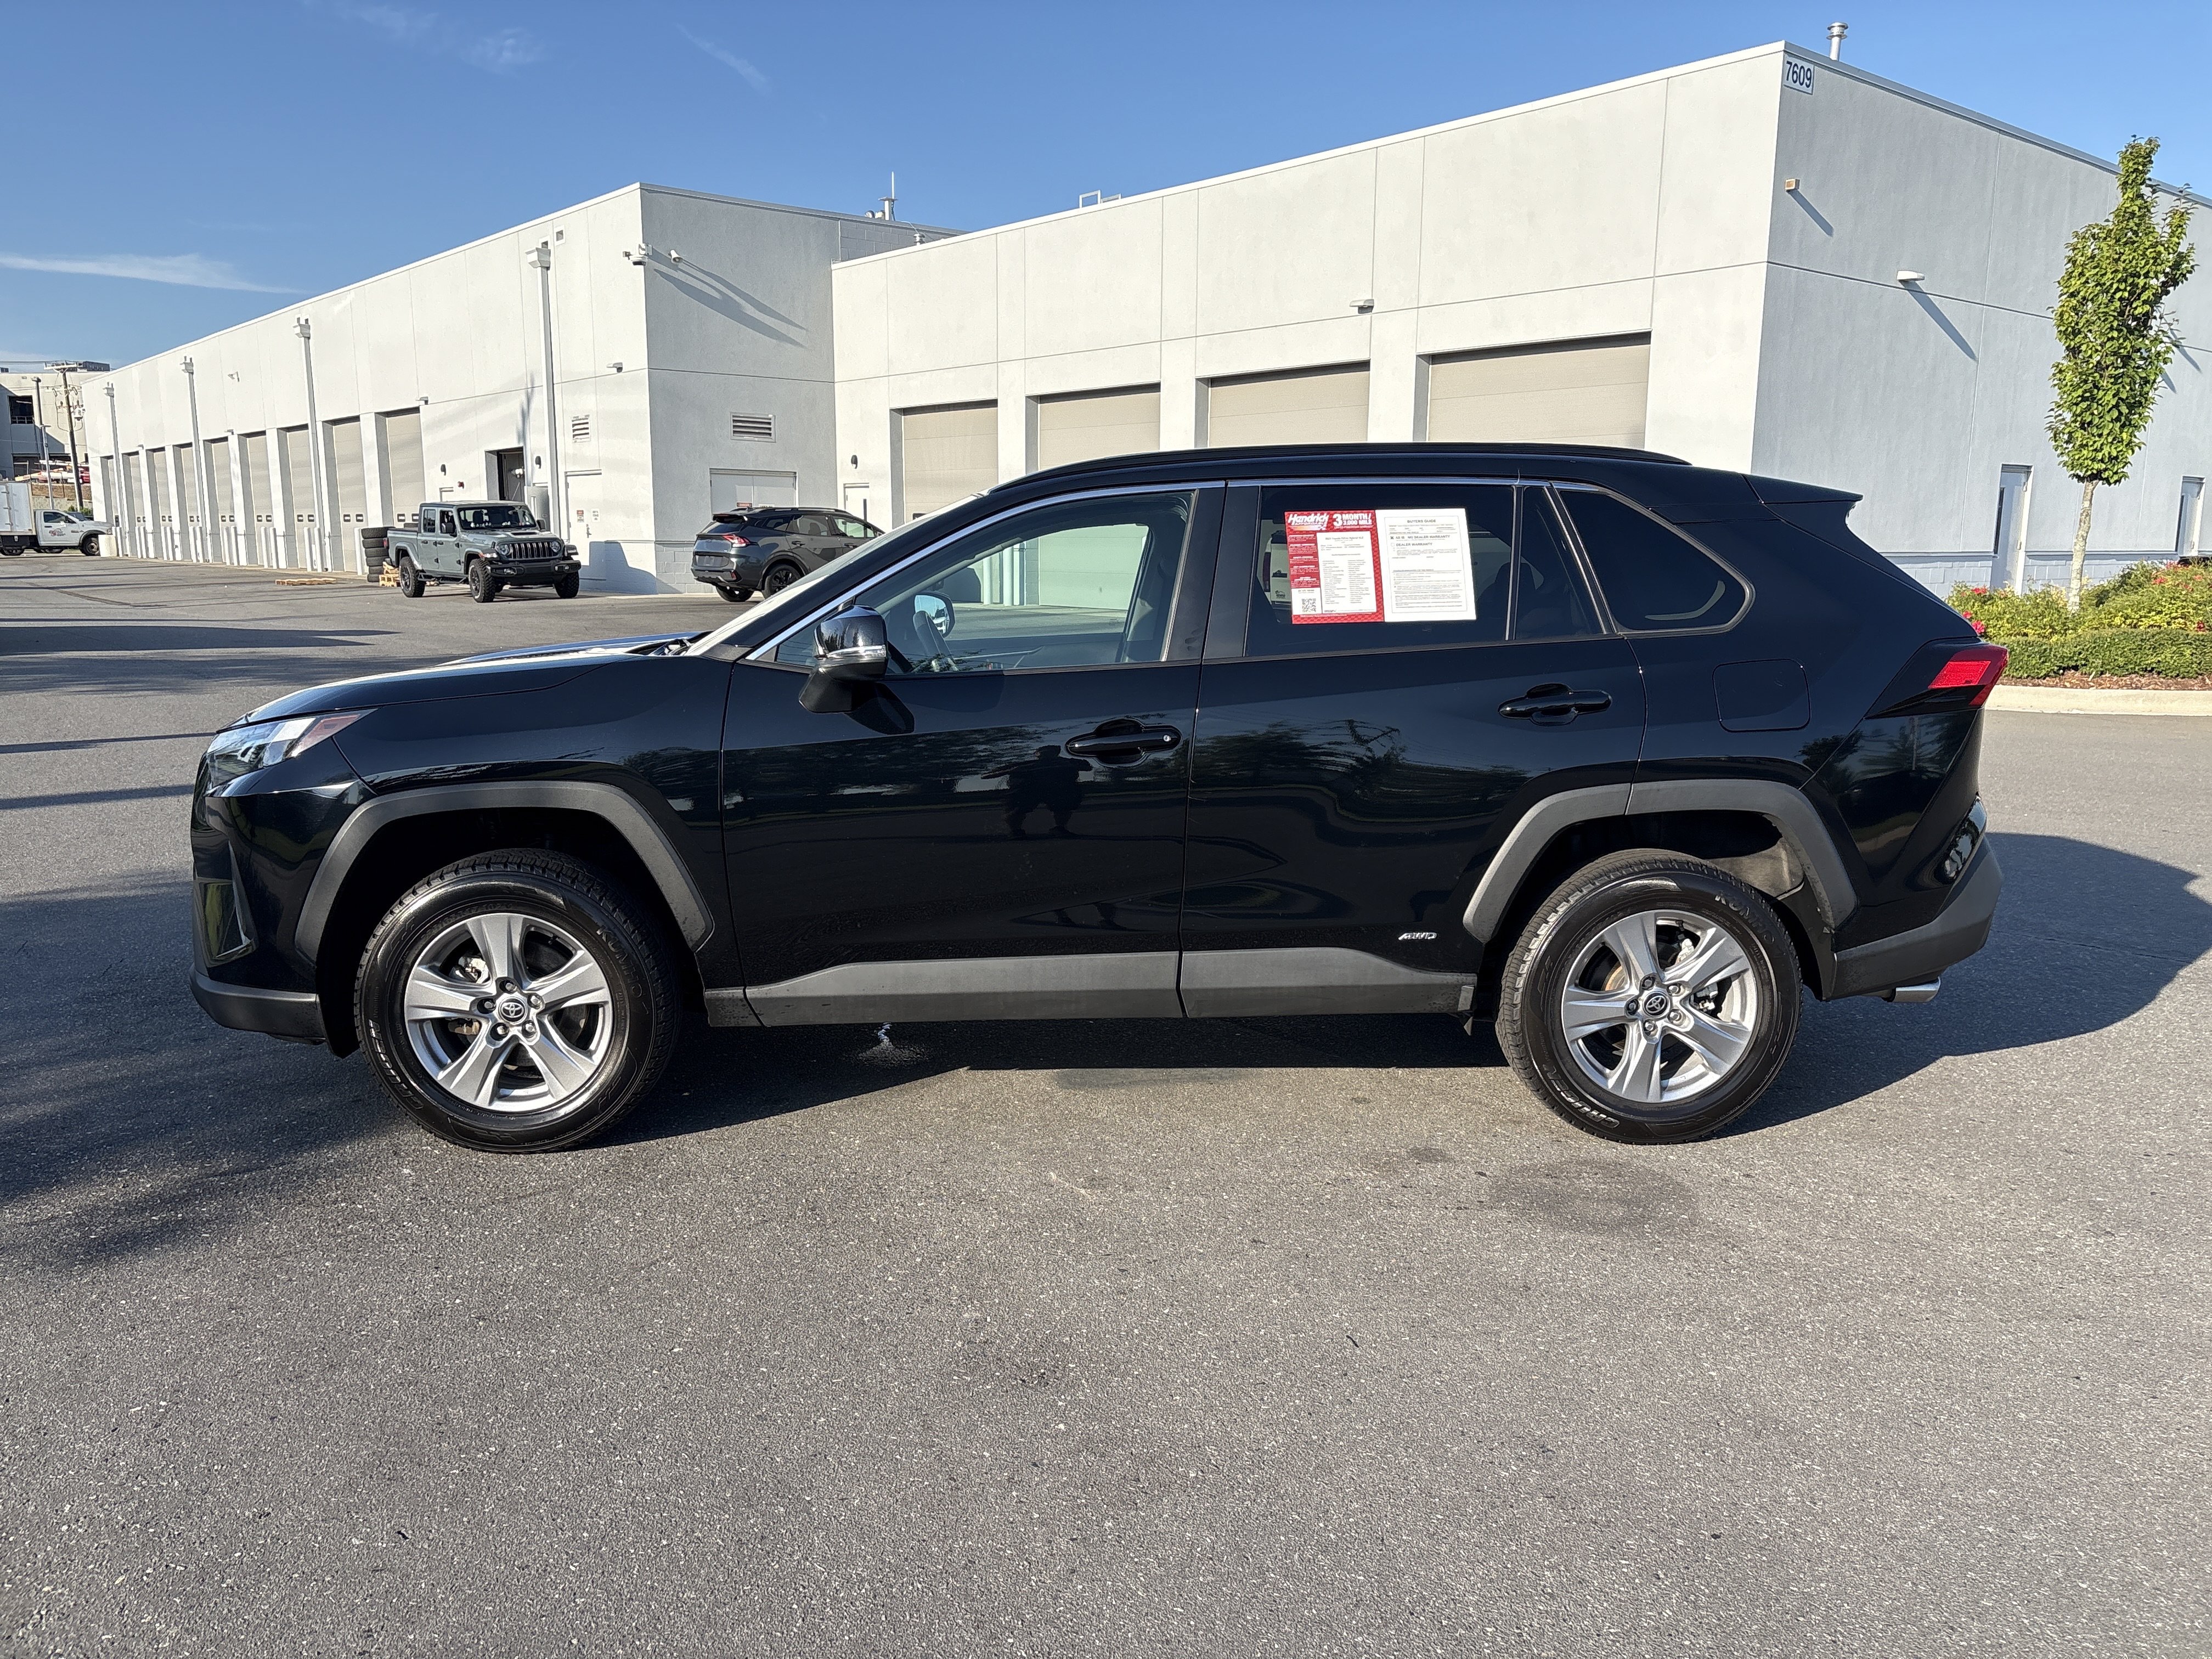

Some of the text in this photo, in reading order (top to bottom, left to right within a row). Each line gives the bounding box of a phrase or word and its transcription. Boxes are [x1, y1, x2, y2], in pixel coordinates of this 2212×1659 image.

[1786, 60, 1812, 88] 7609
[1288, 513, 1329, 525] Hendrick
[1333, 514, 1342, 527] 3
[1714, 890, 1775, 944] KUMHO
[1398, 932, 1437, 940] AWD
[596, 926, 642, 998] KUMHO
